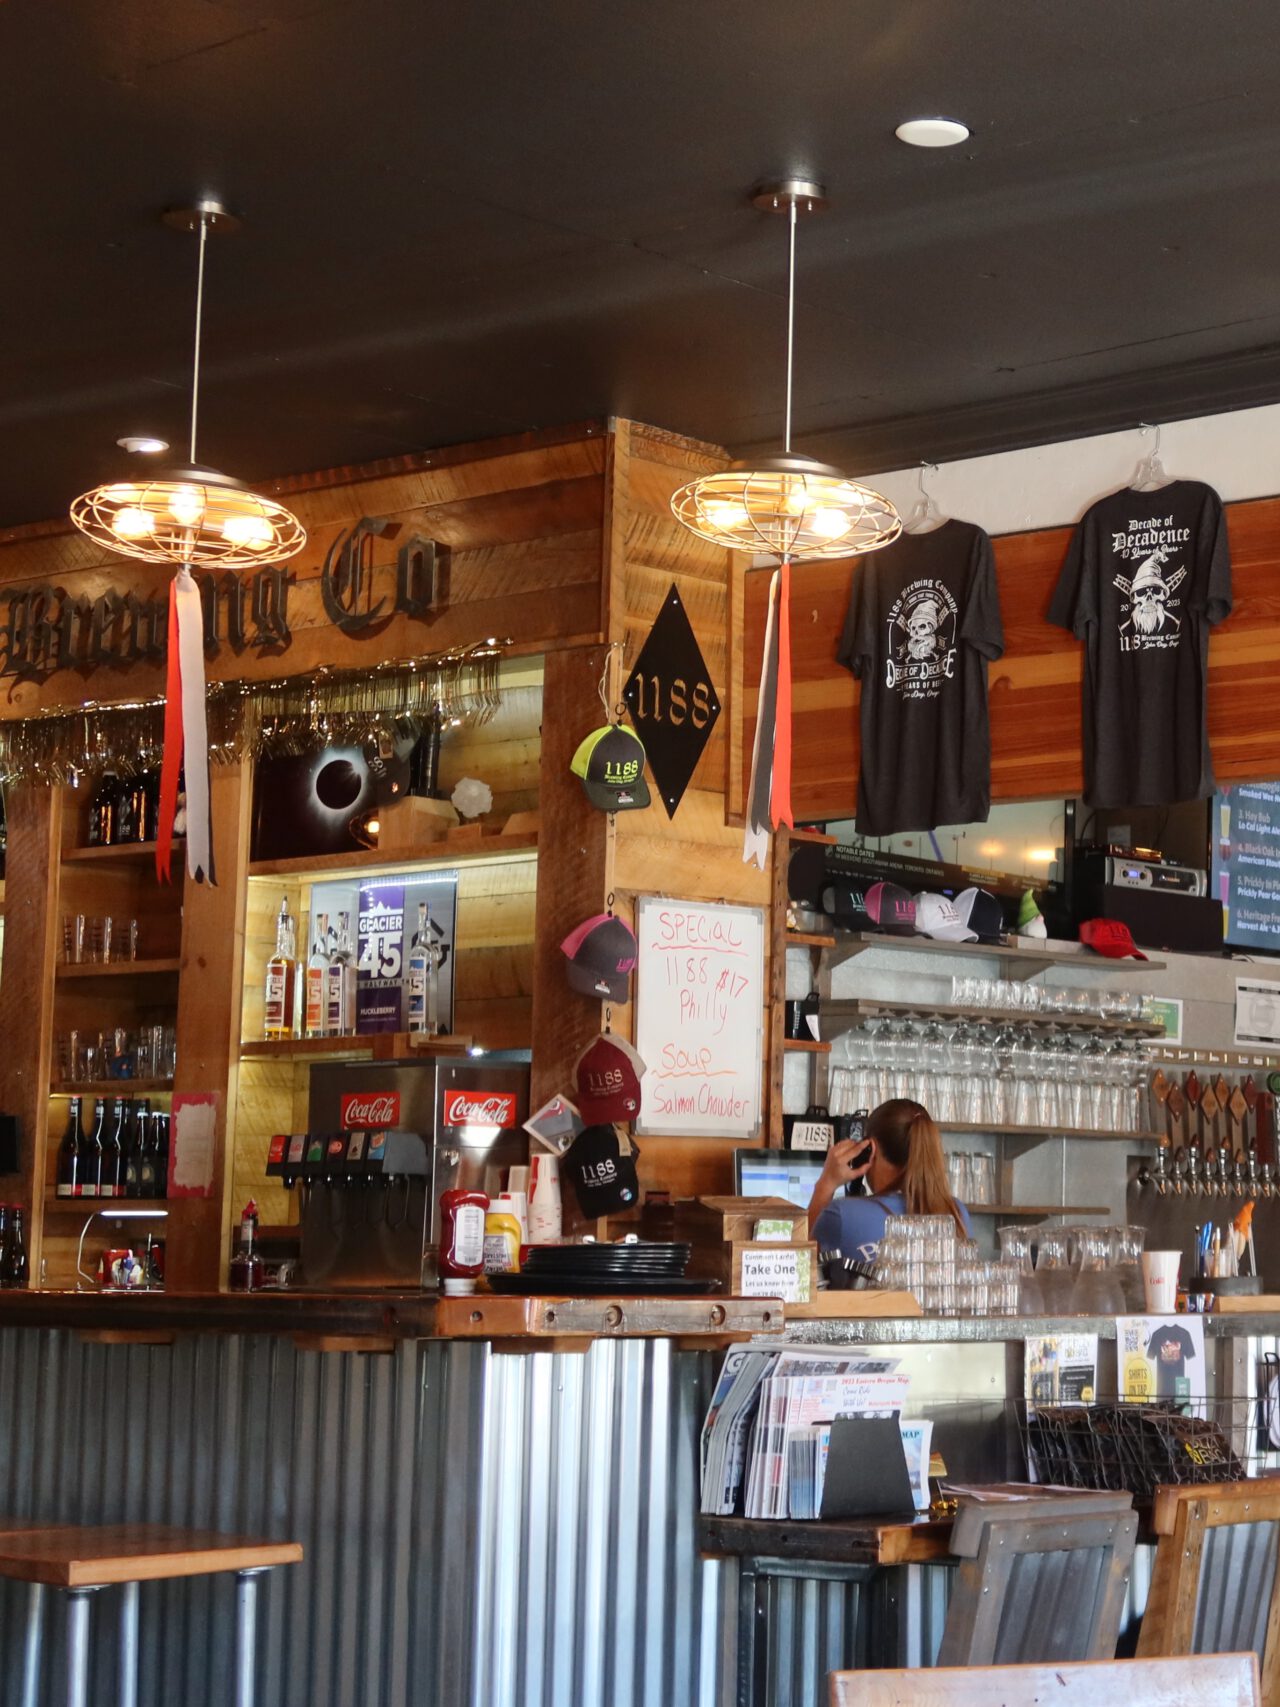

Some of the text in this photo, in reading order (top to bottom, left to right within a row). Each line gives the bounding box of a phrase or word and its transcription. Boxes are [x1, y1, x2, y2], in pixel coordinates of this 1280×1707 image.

[1129, 515, 1173, 532] Decade of
[1112, 528, 1190, 552] Decadence
[0, 517, 450, 674] Brewng Co
[635, 673, 710, 728] 1188
[606, 760, 638, 775] 1188
[360, 916, 402, 933] GLACIER
[359, 931, 401, 978] 45
[666, 956, 708, 985] 1188
[716, 968, 749, 999] $17
[361, 1006, 396, 1015] HUCKLEBERRY
[680, 989, 727, 1036] Philly
[589, 1069, 622, 1086] 1188
[345, 1097, 395, 1124] Coca-Cola
[449, 1095, 511, 1124] Coca-Cola
[582, 1159, 615, 1178] 1188
[745, 1264, 795, 1275] Take One
[1128, 1368, 1147, 1380] SHIRTS
